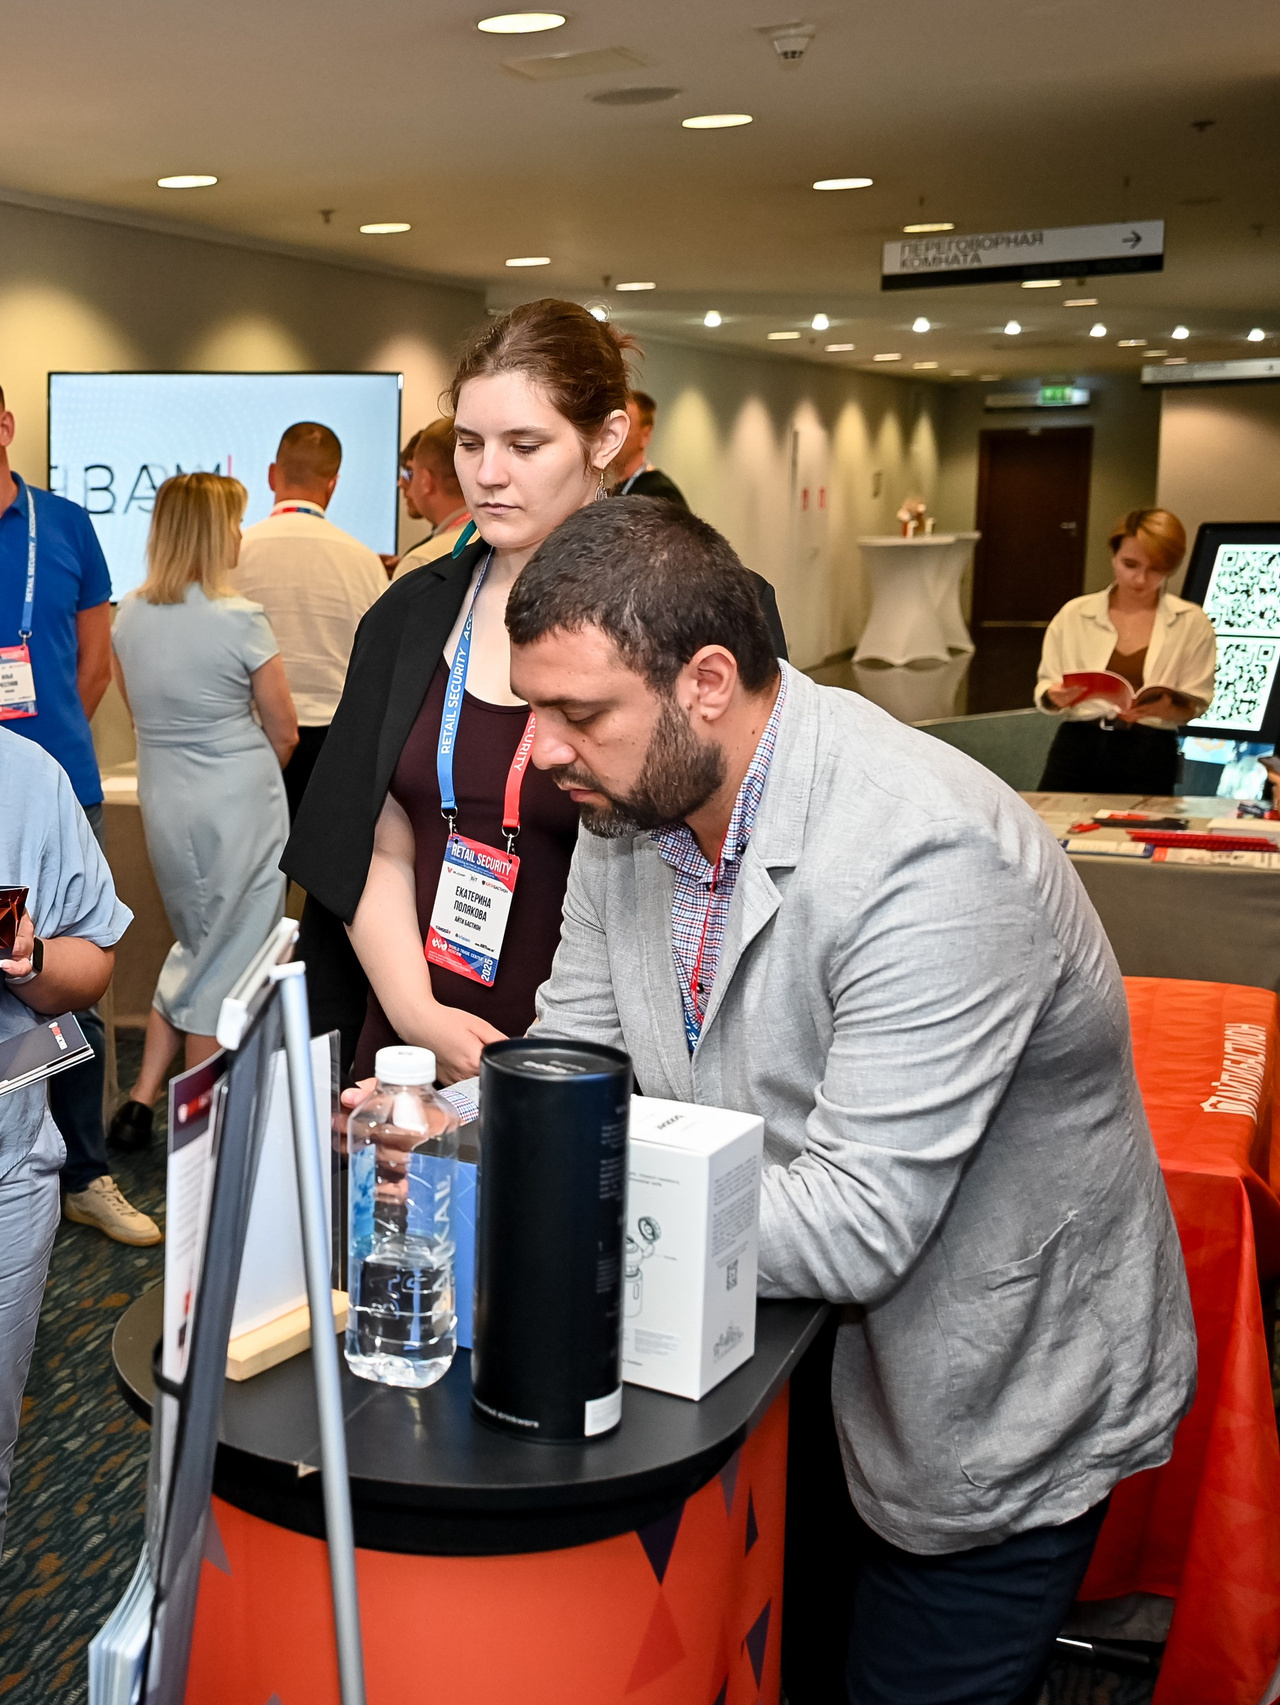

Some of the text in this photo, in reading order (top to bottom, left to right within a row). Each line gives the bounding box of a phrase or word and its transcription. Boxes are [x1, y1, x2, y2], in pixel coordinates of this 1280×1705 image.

[900, 231, 1044, 257] ПЕРЕГОВОРНАЯ
[900, 251, 982, 270] КОМНАТА
[441, 647, 467, 754] RETAIL SECURITY
[451, 844, 476, 863] RETAIL
[476, 853, 512, 875] SECURITY
[455, 885, 491, 909] ЕКАТЕРИНА
[453, 900, 487, 922] ПОЛЯКОВА
[481, 958, 494, 982] 2025
[1211, 1023, 1266, 1109] АЙТИБАСТИОН
